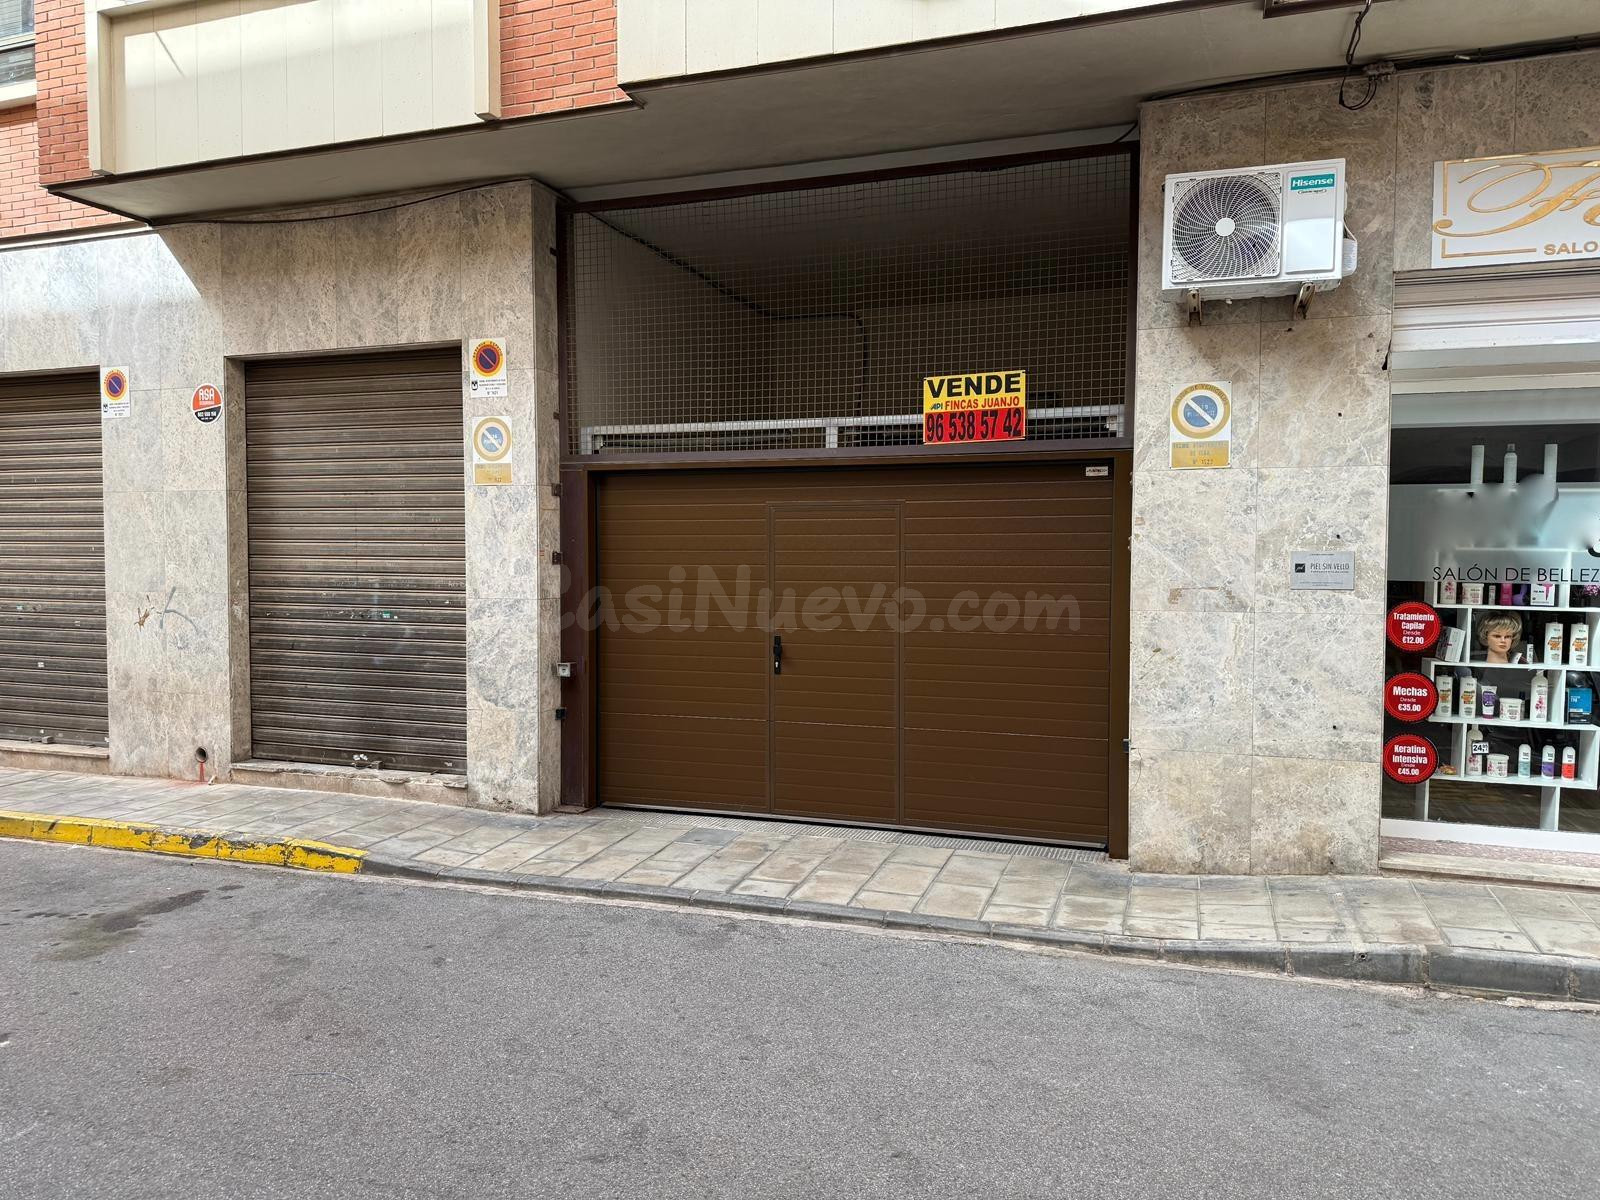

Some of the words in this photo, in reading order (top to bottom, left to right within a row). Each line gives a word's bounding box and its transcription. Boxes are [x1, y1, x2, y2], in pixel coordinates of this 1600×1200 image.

[1292, 178, 1333, 188] Hisense
[927, 373, 1021, 398] VENDE
[945, 398, 979, 411] FINCAS
[981, 396, 1020, 409] JUANJO
[927, 413, 944, 442] 96
[949, 411, 975, 441] 538
[981, 409, 998, 439] 57
[1003, 408, 1021, 438] 42
[1432, 563, 1498, 582] SALÓN
[1506, 567, 1531, 582] DE
[1393, 612, 1435, 621] Tratamiento
[1401, 621, 1426, 630] Capilar
[1402, 636, 1424, 644] €12.00
[1393, 686, 1428, 697] Mechas
[1398, 703, 1422, 712] €35.00
[1394, 744, 1426, 754] Keratina
[1392, 755, 1428, 764] Intensiva
[1398, 767, 1420, 776] €45.00
